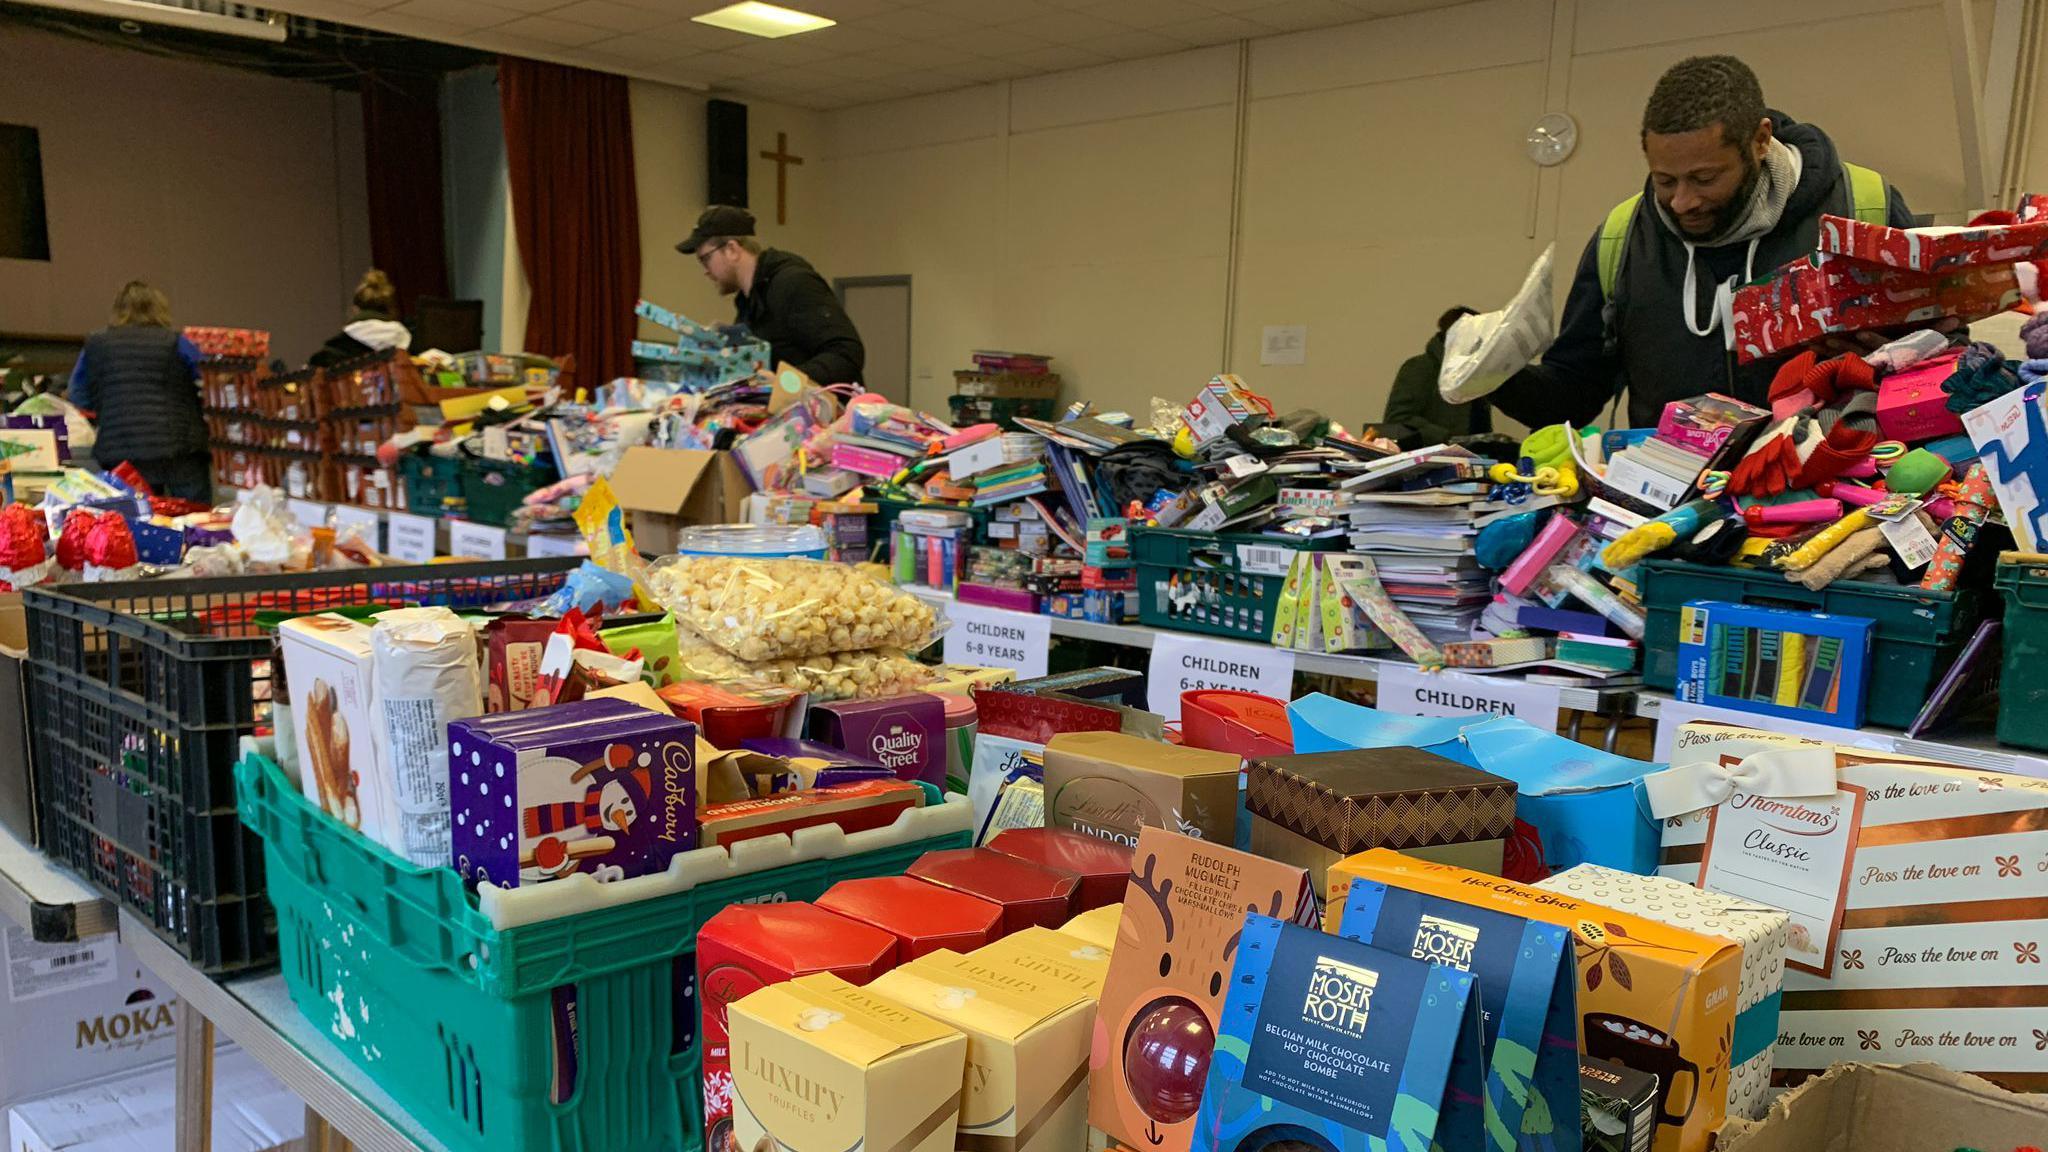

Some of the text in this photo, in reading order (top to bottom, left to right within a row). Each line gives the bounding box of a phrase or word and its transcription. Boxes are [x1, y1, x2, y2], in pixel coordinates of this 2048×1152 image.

[966, 622, 1025, 640] CHILDREN
[966, 641, 1025, 661] 6-8 YEARS
[1182, 655, 1260, 679] CHILDREN
[1416, 689, 1515, 715] CHILDREN
[872, 731, 922, 753] Quality
[1678, 730, 1711, 749] Pass
[878, 751, 920, 767] Street
[657, 741, 692, 842] Cadbury
[1884, 783, 1906, 799] the
[1909, 782, 1939, 797] love
[1943, 783, 1962, 793] on
[1731, 793, 1832, 827] Thorntons
[1743, 829, 1812, 862] Classic
[1191, 853, 1241, 877] RUDOLPH
[1859, 864, 1981, 886] Pass the love on
[1185, 866, 1241, 891] MUG MELT
[1189, 881, 1233, 900] FILLED WITH
[1175, 886, 1217, 906] CHOCOLATE
[1218, 899, 1238, 912] CHIPS
[1461, 877, 1581, 911] Hot Choc Shot
[1178, 896, 1235, 920] MARSHMALLOWS
[1414, 928, 1475, 963] MOSER
[1878, 947, 1999, 966] Pass the love on
[953, 960, 1044, 991] Luxury
[1309, 971, 1374, 1011] MOSER
[1303, 993, 1368, 1033] ROTH
[1265, 1023, 1391, 1073] BELGIAN MILK CHOCOLATE
[1777, 1031, 1845, 1046] the love on
[1895, 1029, 2017, 1047] Pass the love on
[710, 1048, 727, 1057] MILK
[1284, 1041, 1365, 1076] HOT CHOCOLATE
[744, 1040, 845, 1123] Luxury
[1303, 1060, 1339, 1079] BOMBE
[1258, 1074, 1374, 1120] HOT CHOCOLATE WITH MARSHMALLOWS
[1264, 1069, 1277, 1077] ADD
[1287, 1077, 1300, 1085] HOT
[1301, 1081, 1316, 1091] MILK
[1317, 1088, 1329, 1096] FOR
[1336, 1094, 1371, 1111] LUXURIOUS
[768, 1093, 816, 1122] TRUFFLES
